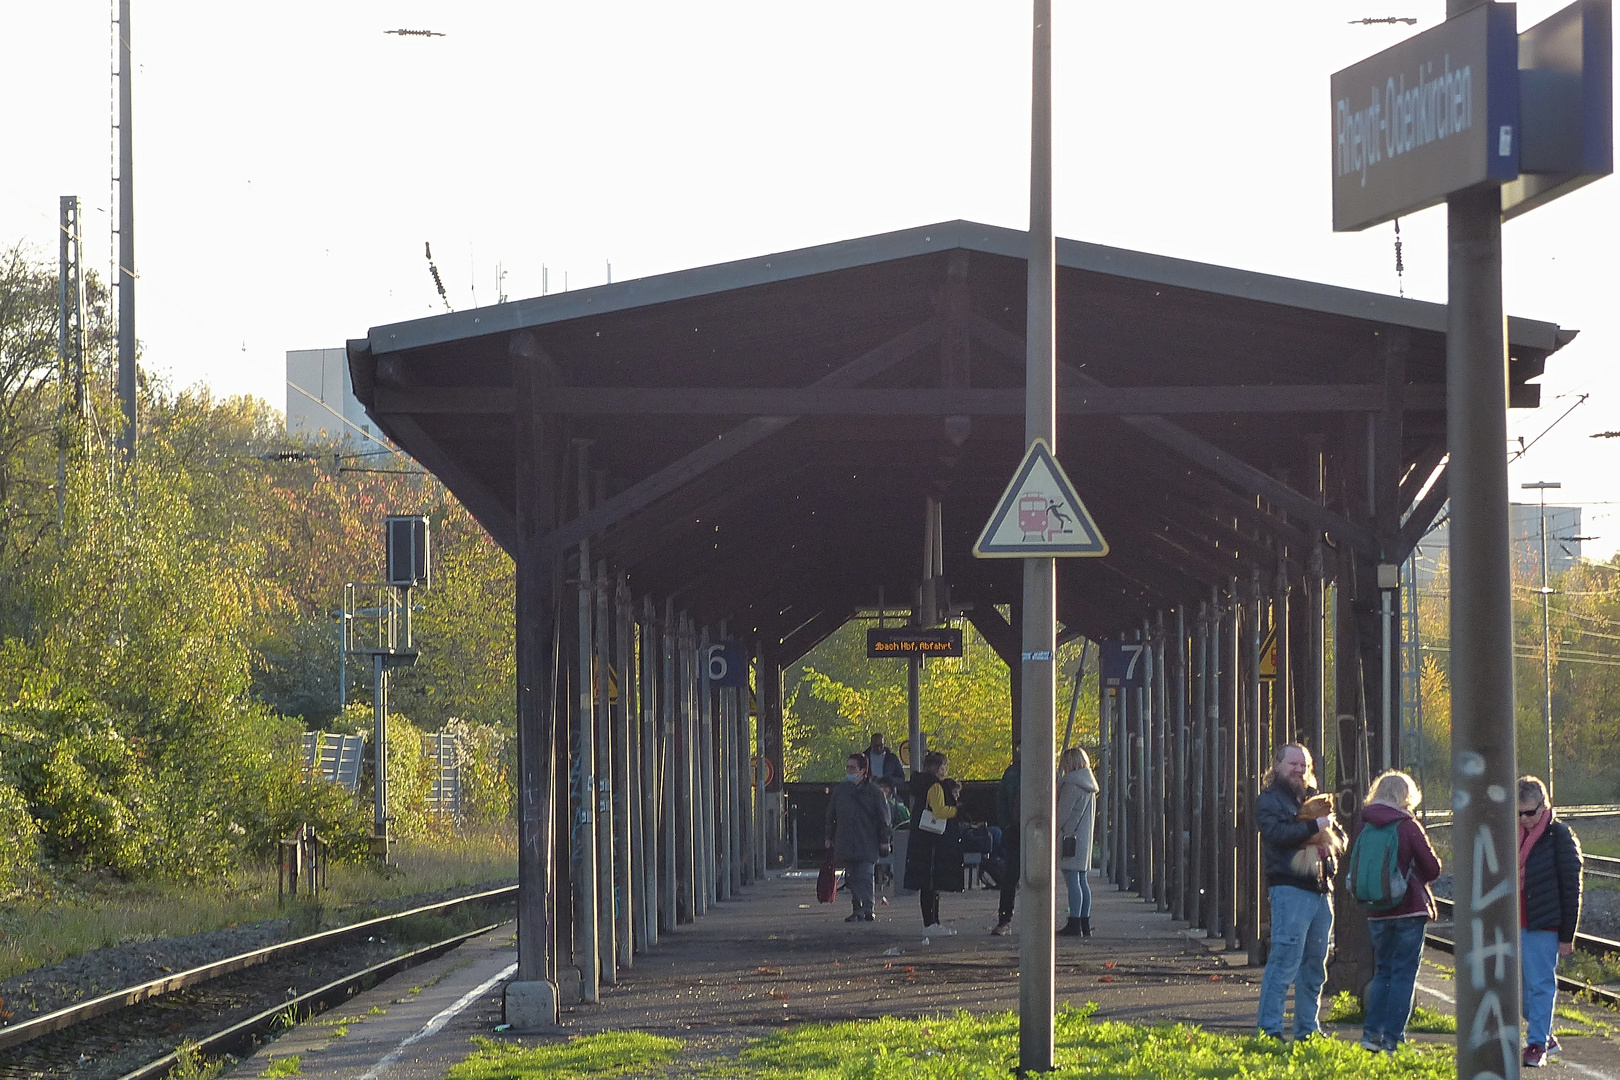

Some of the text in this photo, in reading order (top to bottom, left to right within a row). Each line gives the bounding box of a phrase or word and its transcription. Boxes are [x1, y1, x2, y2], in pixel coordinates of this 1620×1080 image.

[1337, 53, 1472, 187] Rheydt-Odenkirchen
[708, 644, 728, 681] 6
[920, 642, 952, 650] Abfahrt
[1121, 644, 1144, 680] 7
